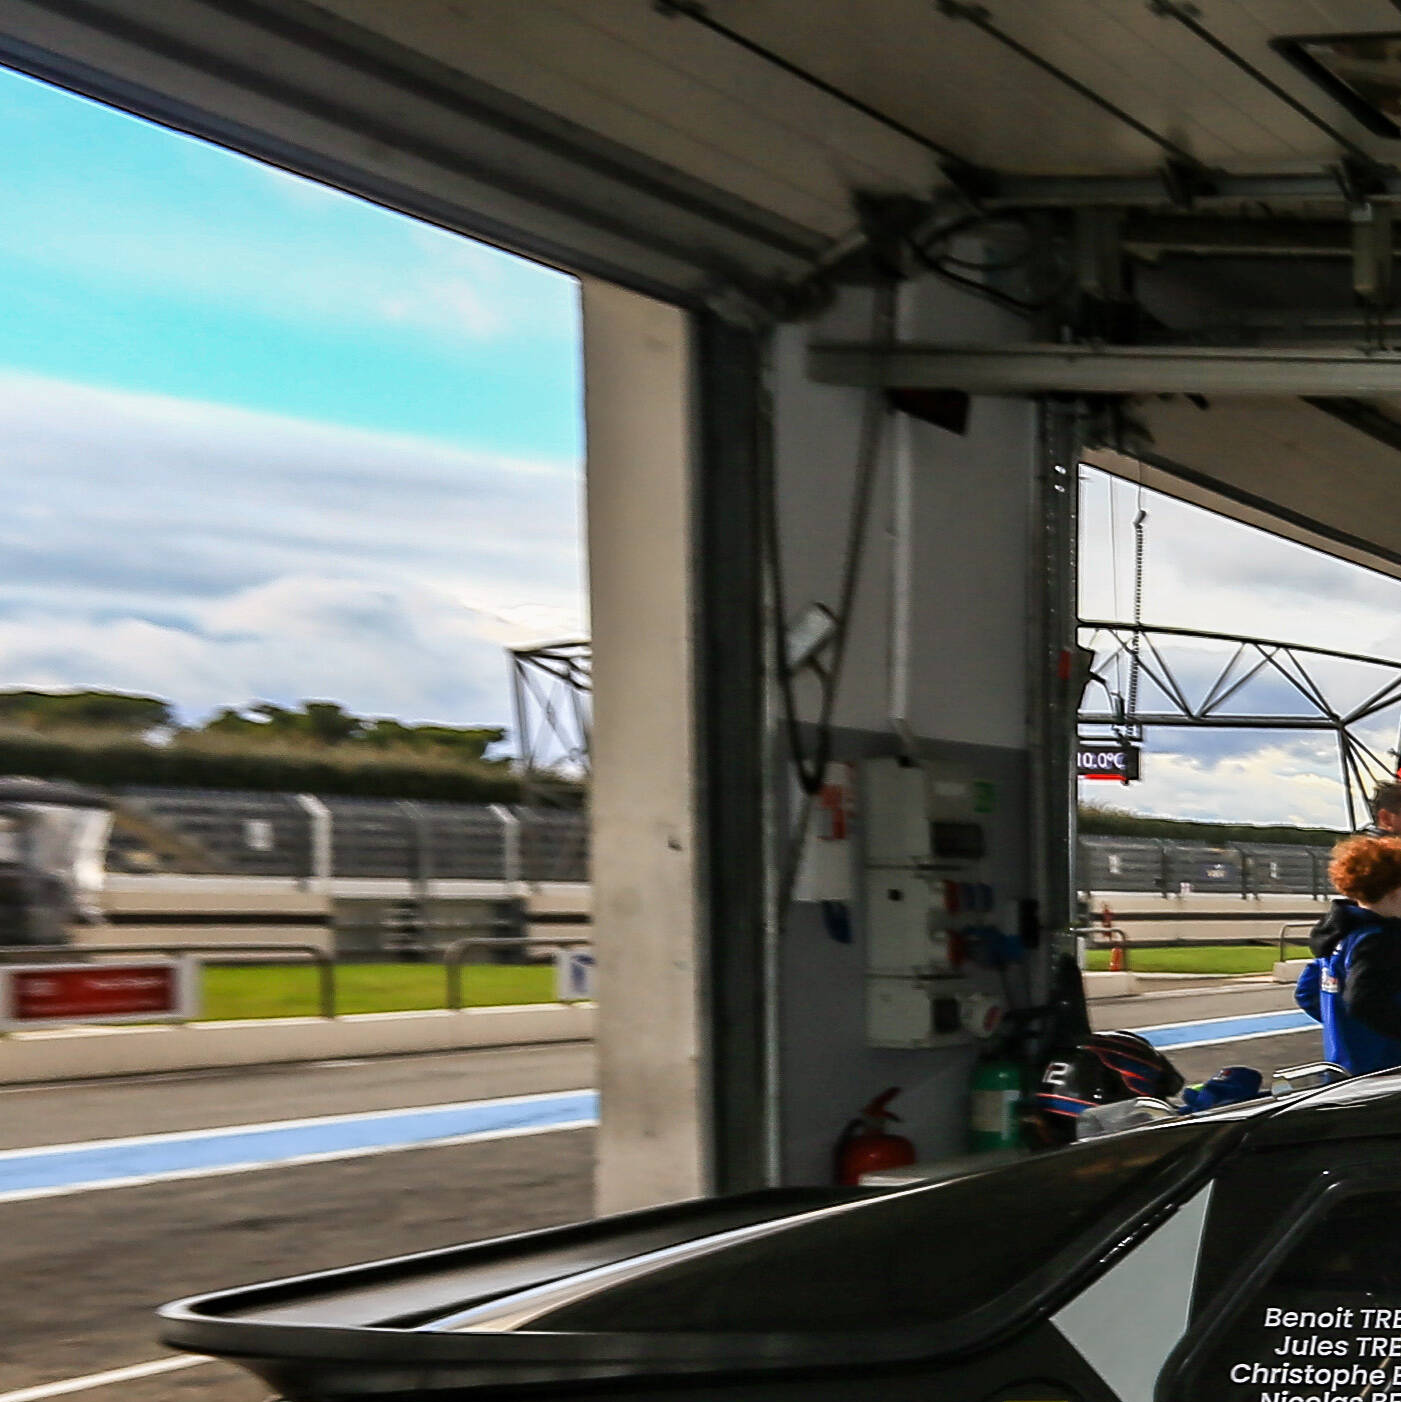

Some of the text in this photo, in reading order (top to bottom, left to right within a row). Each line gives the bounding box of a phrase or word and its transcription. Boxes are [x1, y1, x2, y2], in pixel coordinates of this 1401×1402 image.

[1264, 1307, 1354, 1329] Benoit
[1274, 1335, 1350, 1357] Jules
[1229, 1362, 1386, 1392] Christophe
